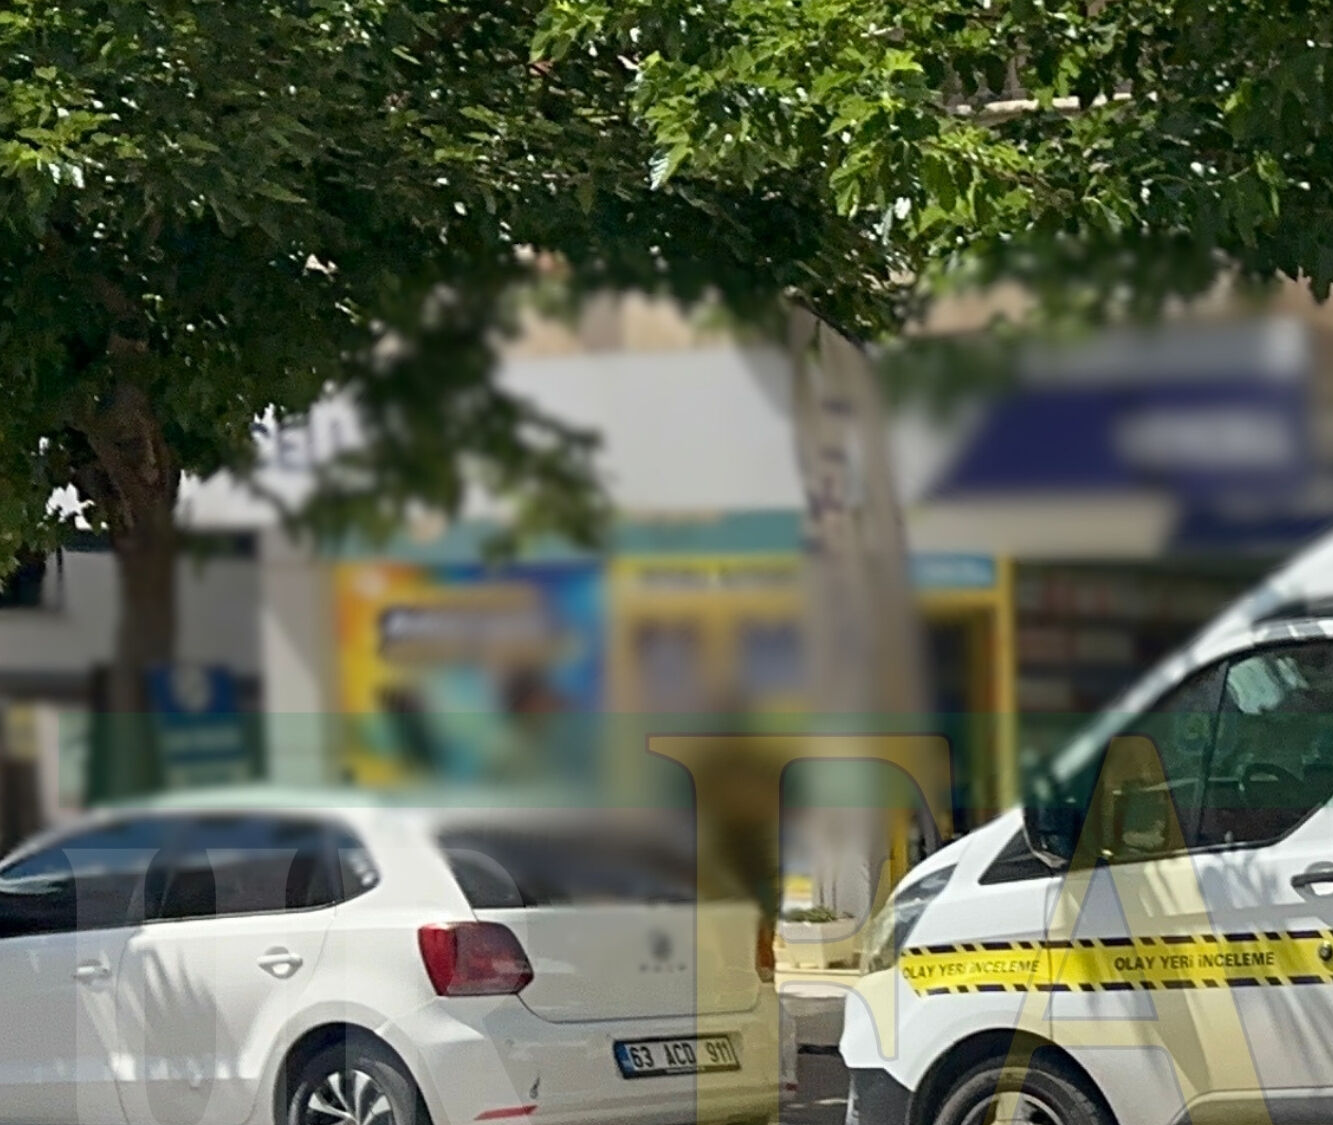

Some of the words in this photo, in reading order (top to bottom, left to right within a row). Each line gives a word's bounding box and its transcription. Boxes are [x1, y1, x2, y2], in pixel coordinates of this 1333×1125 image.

[1114, 956, 1156, 971] OLAY
[629, 1046, 655, 1069] 63
[664, 1043, 697, 1066] ACD
[705, 1041, 733, 1063] 911
